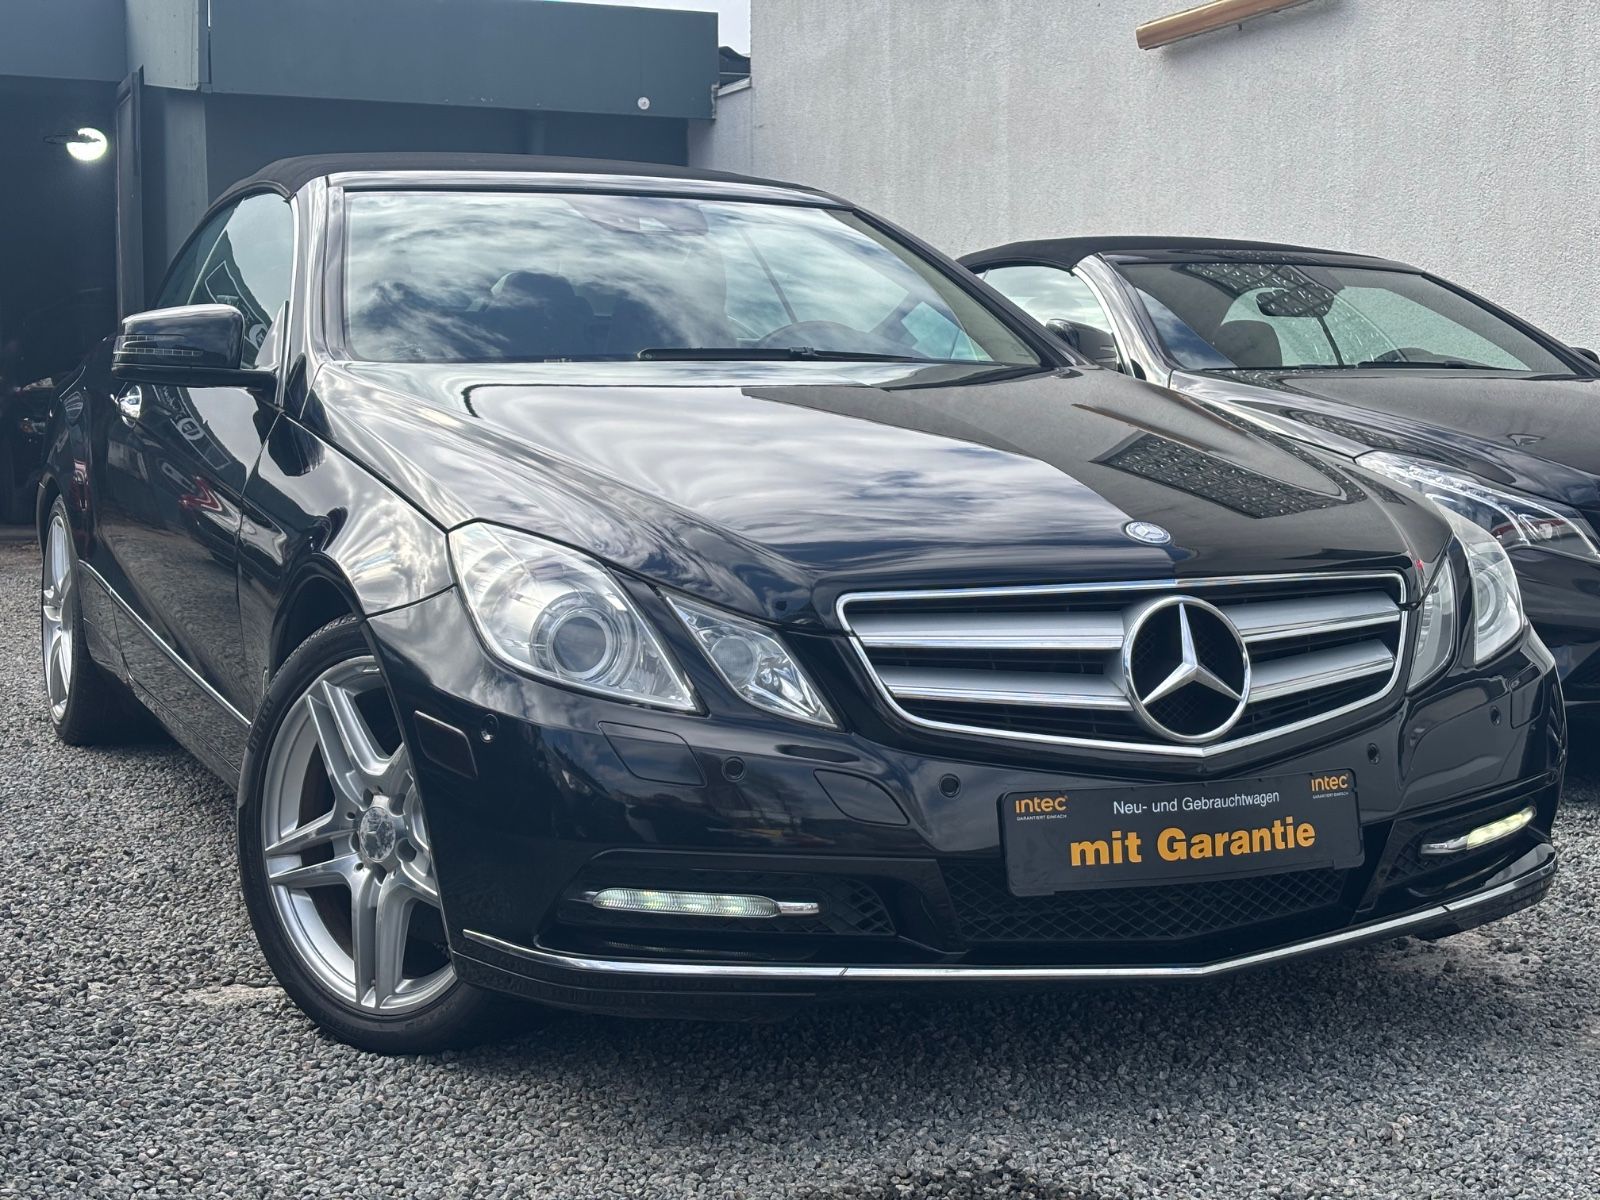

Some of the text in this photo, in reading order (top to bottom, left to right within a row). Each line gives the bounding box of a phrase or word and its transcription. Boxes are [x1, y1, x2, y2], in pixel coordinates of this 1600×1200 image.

[1311, 775, 1348, 792] intec
[1015, 796, 1067, 813] intec
[1113, 791, 1280, 815] Neu- und Gebrauchtwagen
[1070, 816, 1316, 866] mit Garantie
